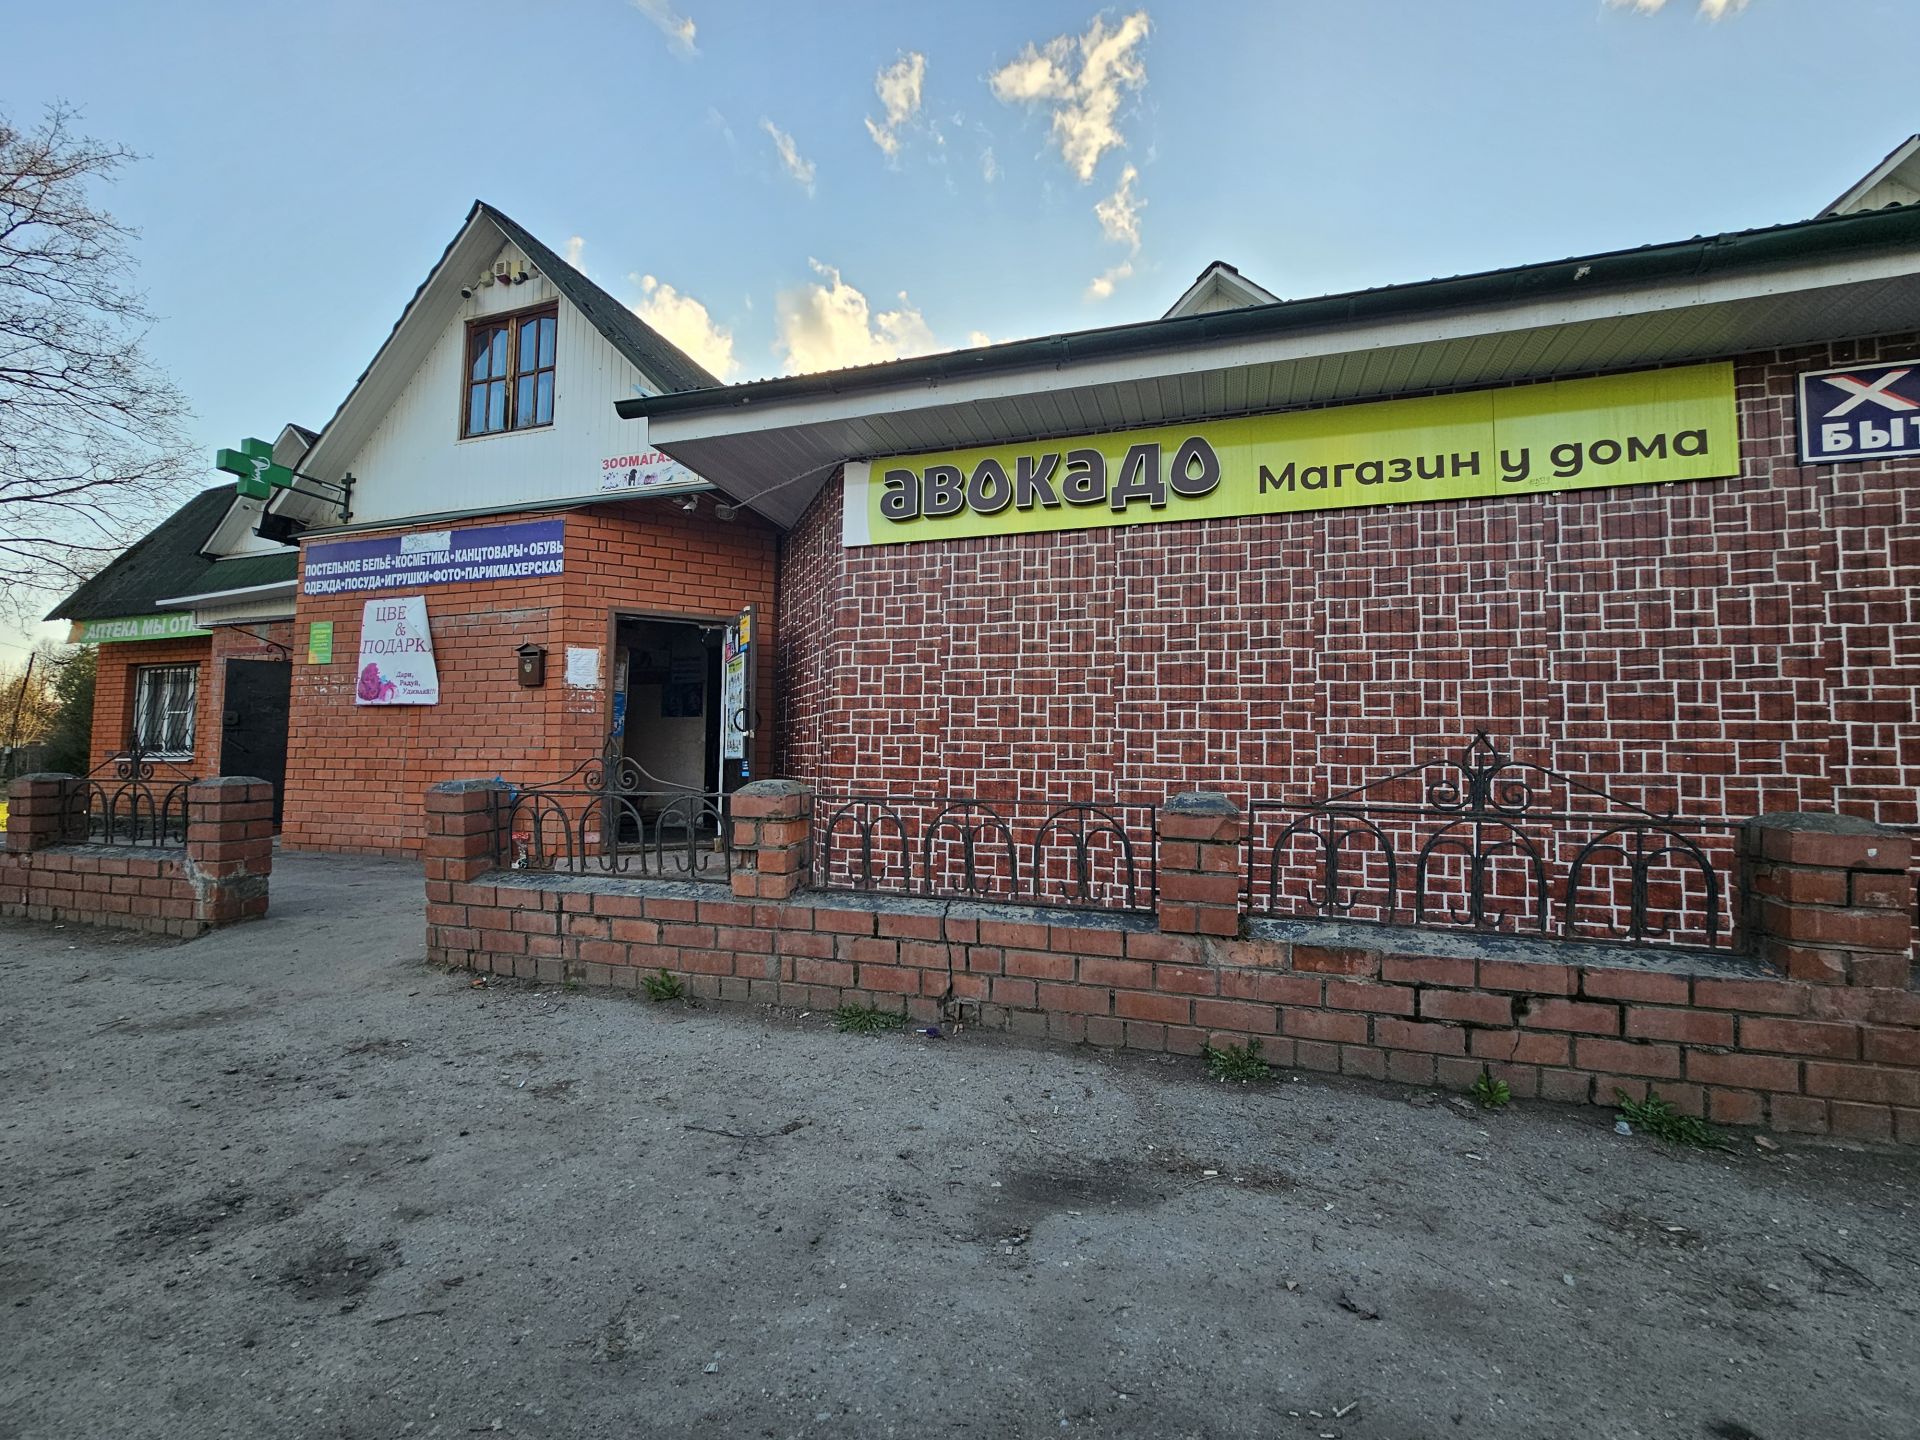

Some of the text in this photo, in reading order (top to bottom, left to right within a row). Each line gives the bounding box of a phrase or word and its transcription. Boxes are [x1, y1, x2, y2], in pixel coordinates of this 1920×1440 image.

[880, 435, 1223, 522] авокадо
[1257, 428, 1711, 495] Магазин у дома
[304, 559, 563, 594] ОДЕЖДА ПОСУДА ИГРУШКИ ФОТО ПАРИКМАХЕРСКАЯ
[305, 559, 361, 577] ПОСТЕЛЬНОЕ
[395, 551, 450, 569] КОСМЕТИКА
[455, 543, 523, 563] КАНЦТОВАРЫ
[529, 540, 564, 556] ОБУВЬ
[85, 621, 138, 639] АПТЕКА
[142, 618, 167, 636] МЫ
[361, 637, 432, 656] ПОДАРК
